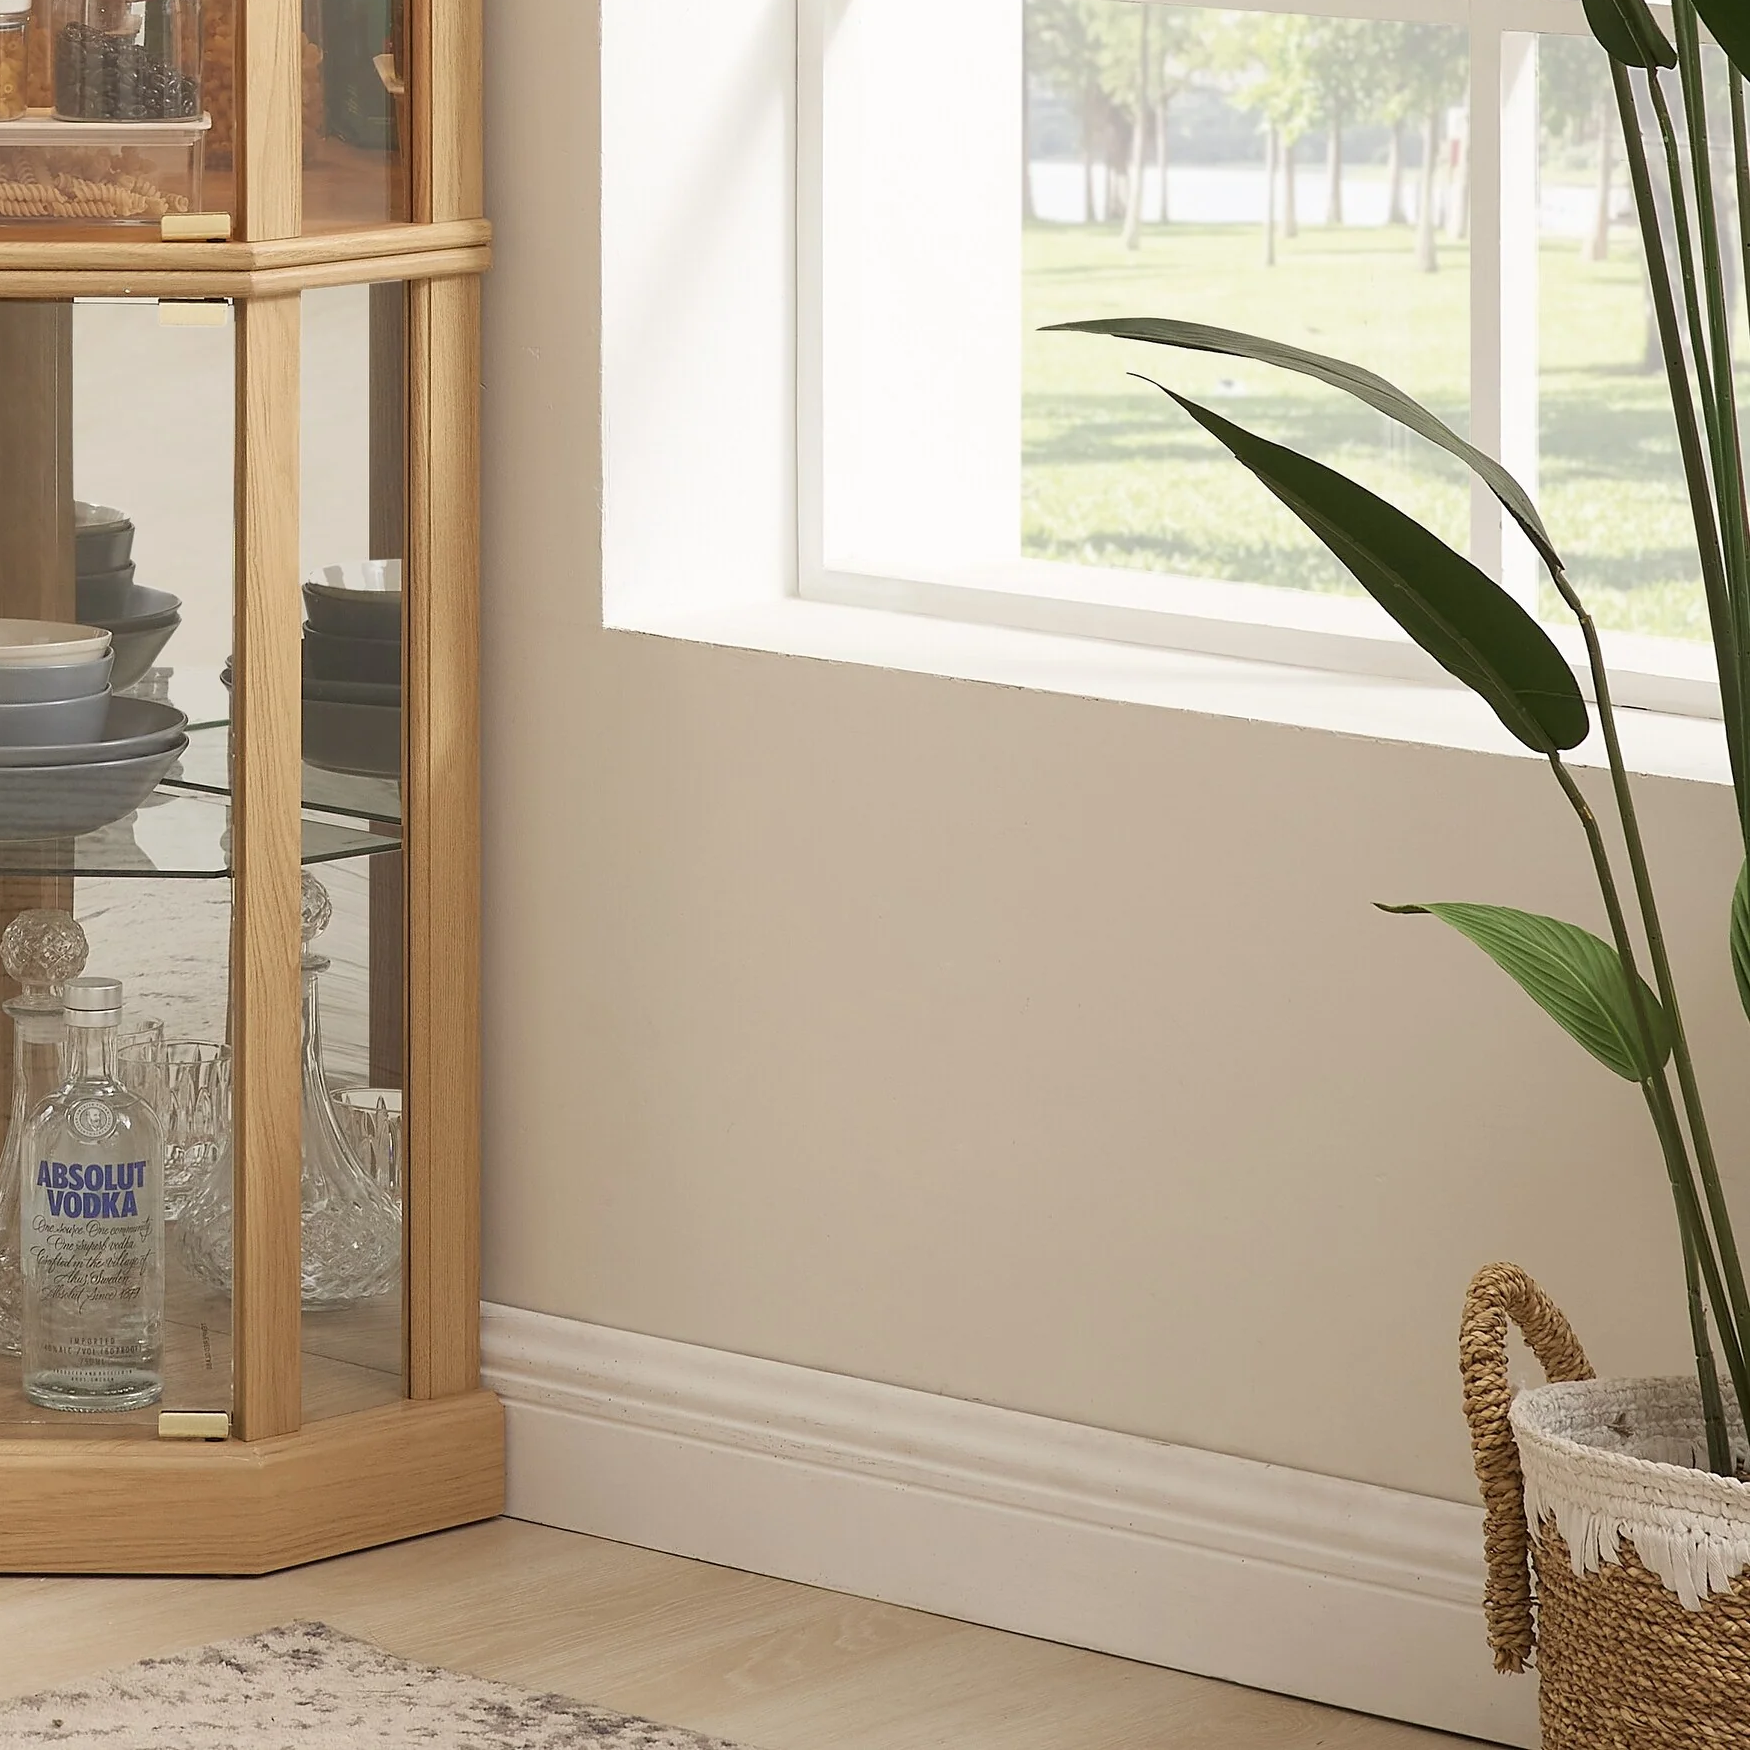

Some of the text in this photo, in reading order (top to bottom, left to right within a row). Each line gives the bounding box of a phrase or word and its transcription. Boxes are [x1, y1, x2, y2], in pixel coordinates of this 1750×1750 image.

[37, 1160, 147, 1191] ABSOLUT
[47, 1189, 138, 1219] VODKA
[70, 1337, 115, 1345] IMPORTED
